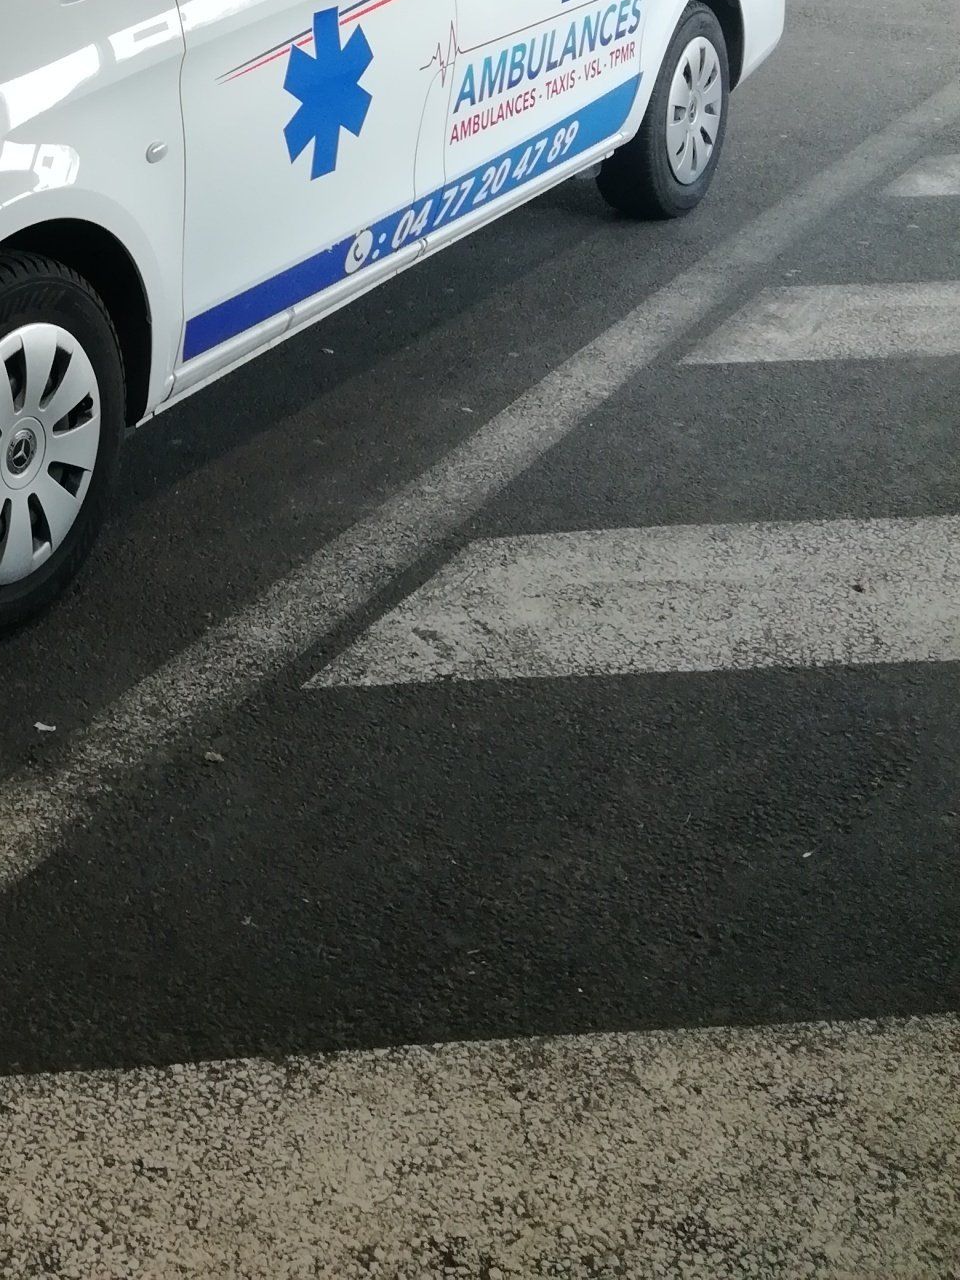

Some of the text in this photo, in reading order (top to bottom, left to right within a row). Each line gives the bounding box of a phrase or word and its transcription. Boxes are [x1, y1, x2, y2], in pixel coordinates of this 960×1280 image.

[449, 88, 536, 145] AMBULANCES
[545, 70, 576, 100] TAXIS
[584, 58, 602, 81] VSL
[609, 41, 636, 69] TPMR
[391, 200, 433, 249] 04
[433, 176, 476, 227] 77
[472, 157, 512, 205] 20
[512, 137, 548, 180] 47
[547, 120, 580, 163] 89
